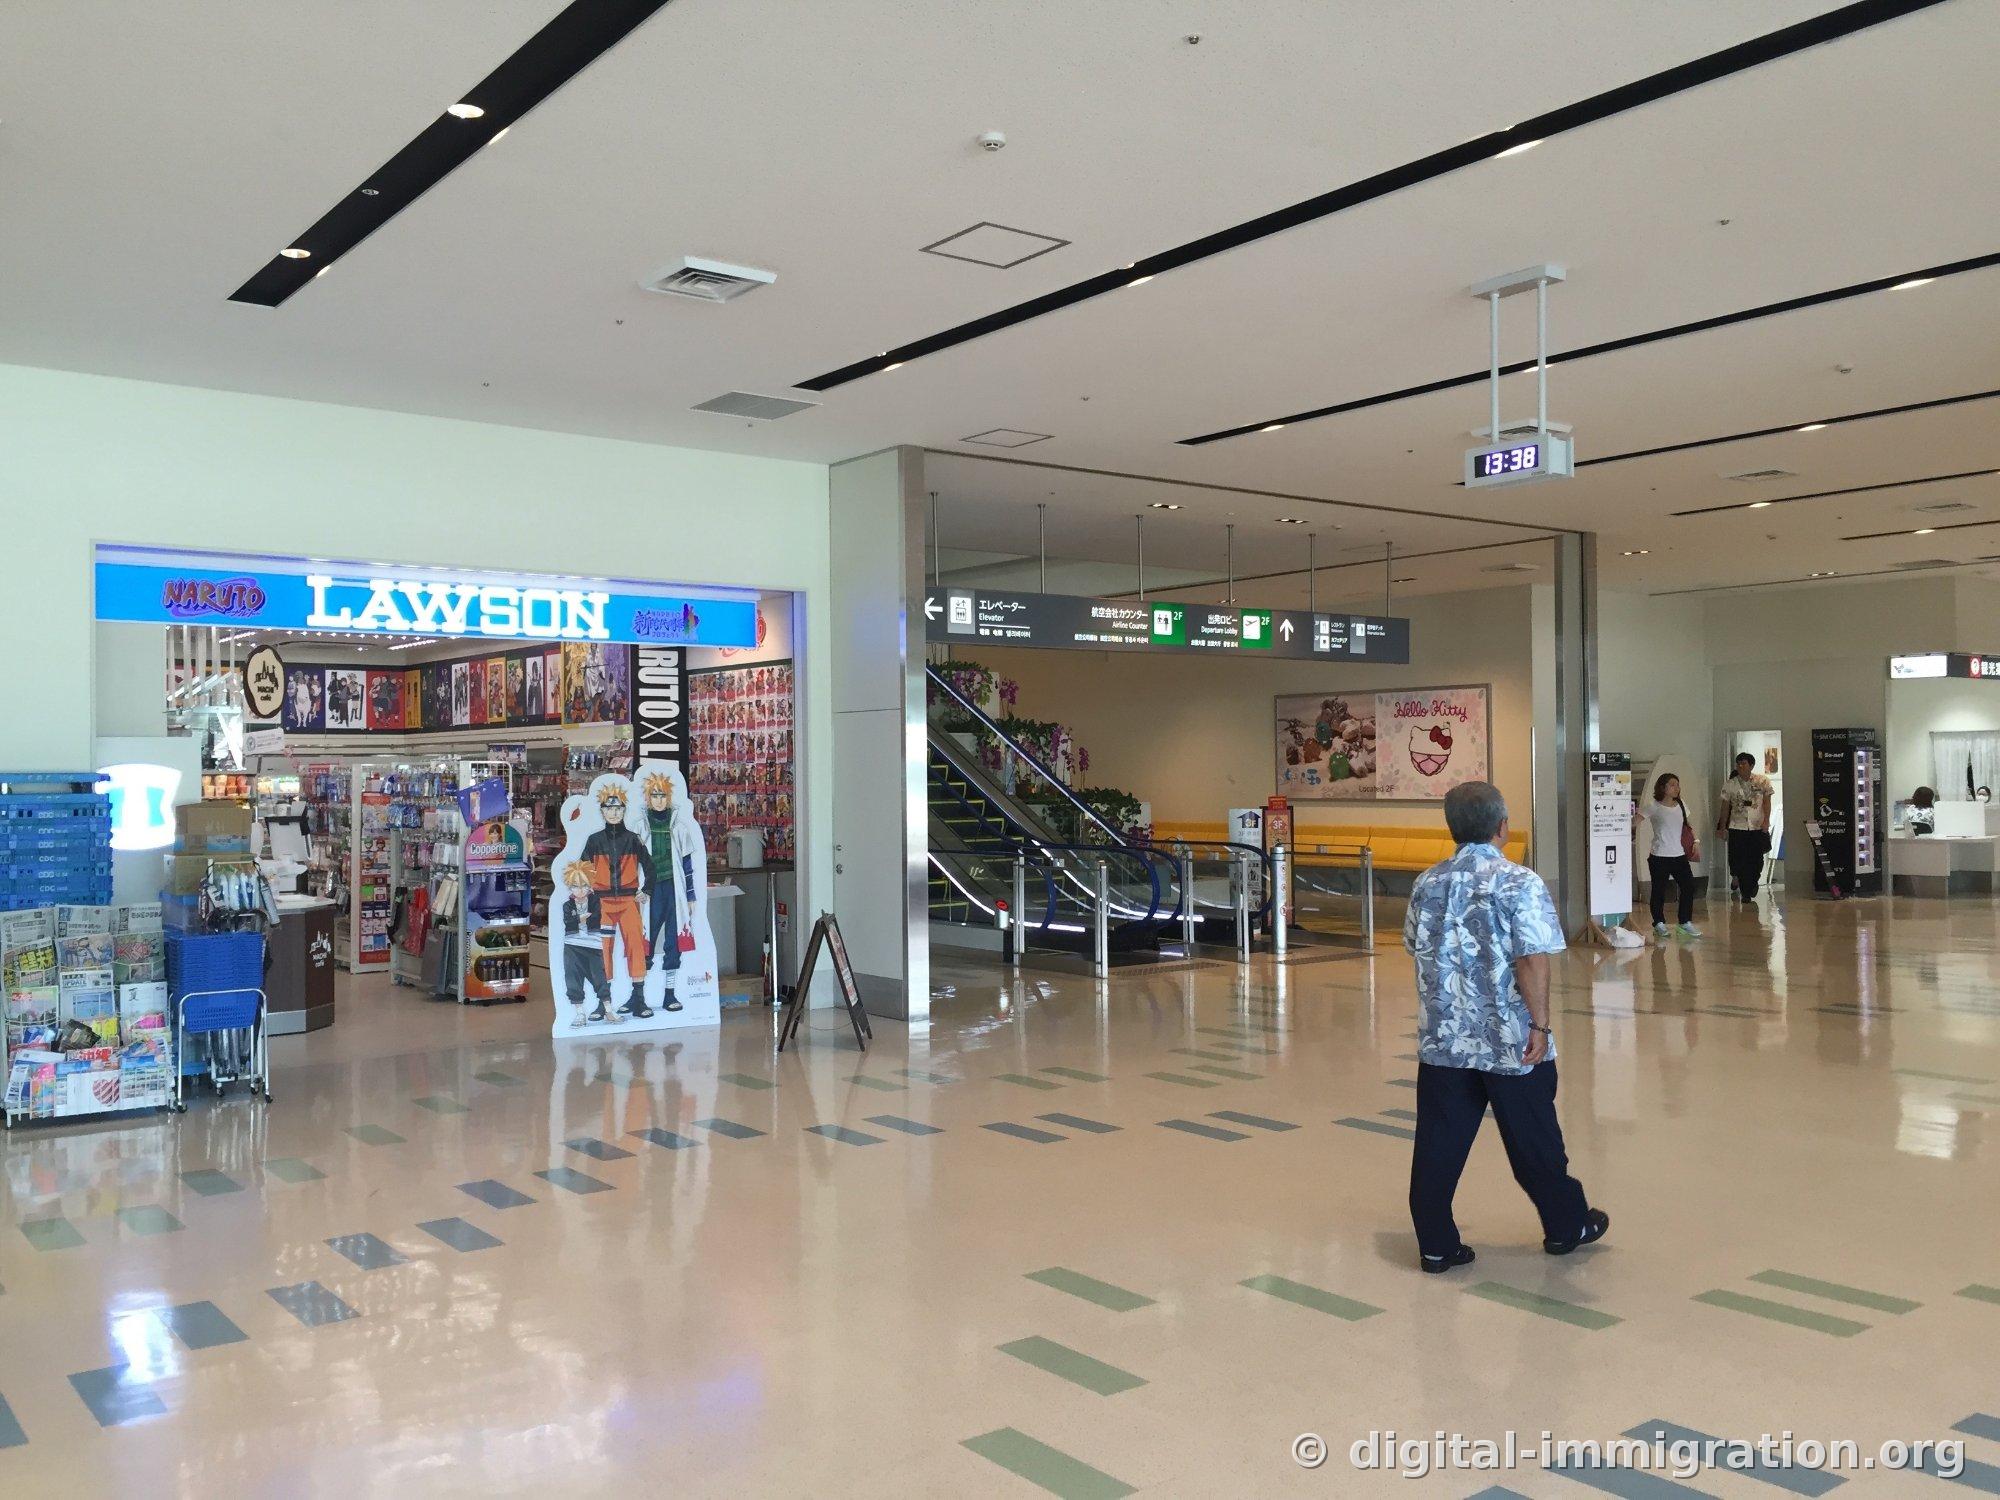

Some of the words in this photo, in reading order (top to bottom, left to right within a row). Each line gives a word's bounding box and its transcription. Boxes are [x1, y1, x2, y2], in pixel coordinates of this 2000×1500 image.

[1485, 446, 1536, 475] 13:38
[163, 578, 266, 614] NARUTO
[306, 574, 610, 639] LAWSON
[978, 600, 1027, 612] エレベーター
[978, 613, 1005, 622] Elevator
[1091, 606, 1149, 620] 航空会社カウンター
[1173, 611, 1183, 621] 2F
[1207, 614, 1238, 625] 出発ロビー
[1260, 616, 1270, 626] 2F
[1112, 621, 1128, 630] Airline
[1129, 622, 1149, 631] Counter
[1224, 627, 1238, 636] Lobby
[1393, 701, 1429, 719] Hello
[1431, 699, 1468, 723] Kitty
[1245, 818, 1257, 828] 3F
[1272, 819, 1283, 830] 3F
[470, 842, 518, 857] Coppertone
